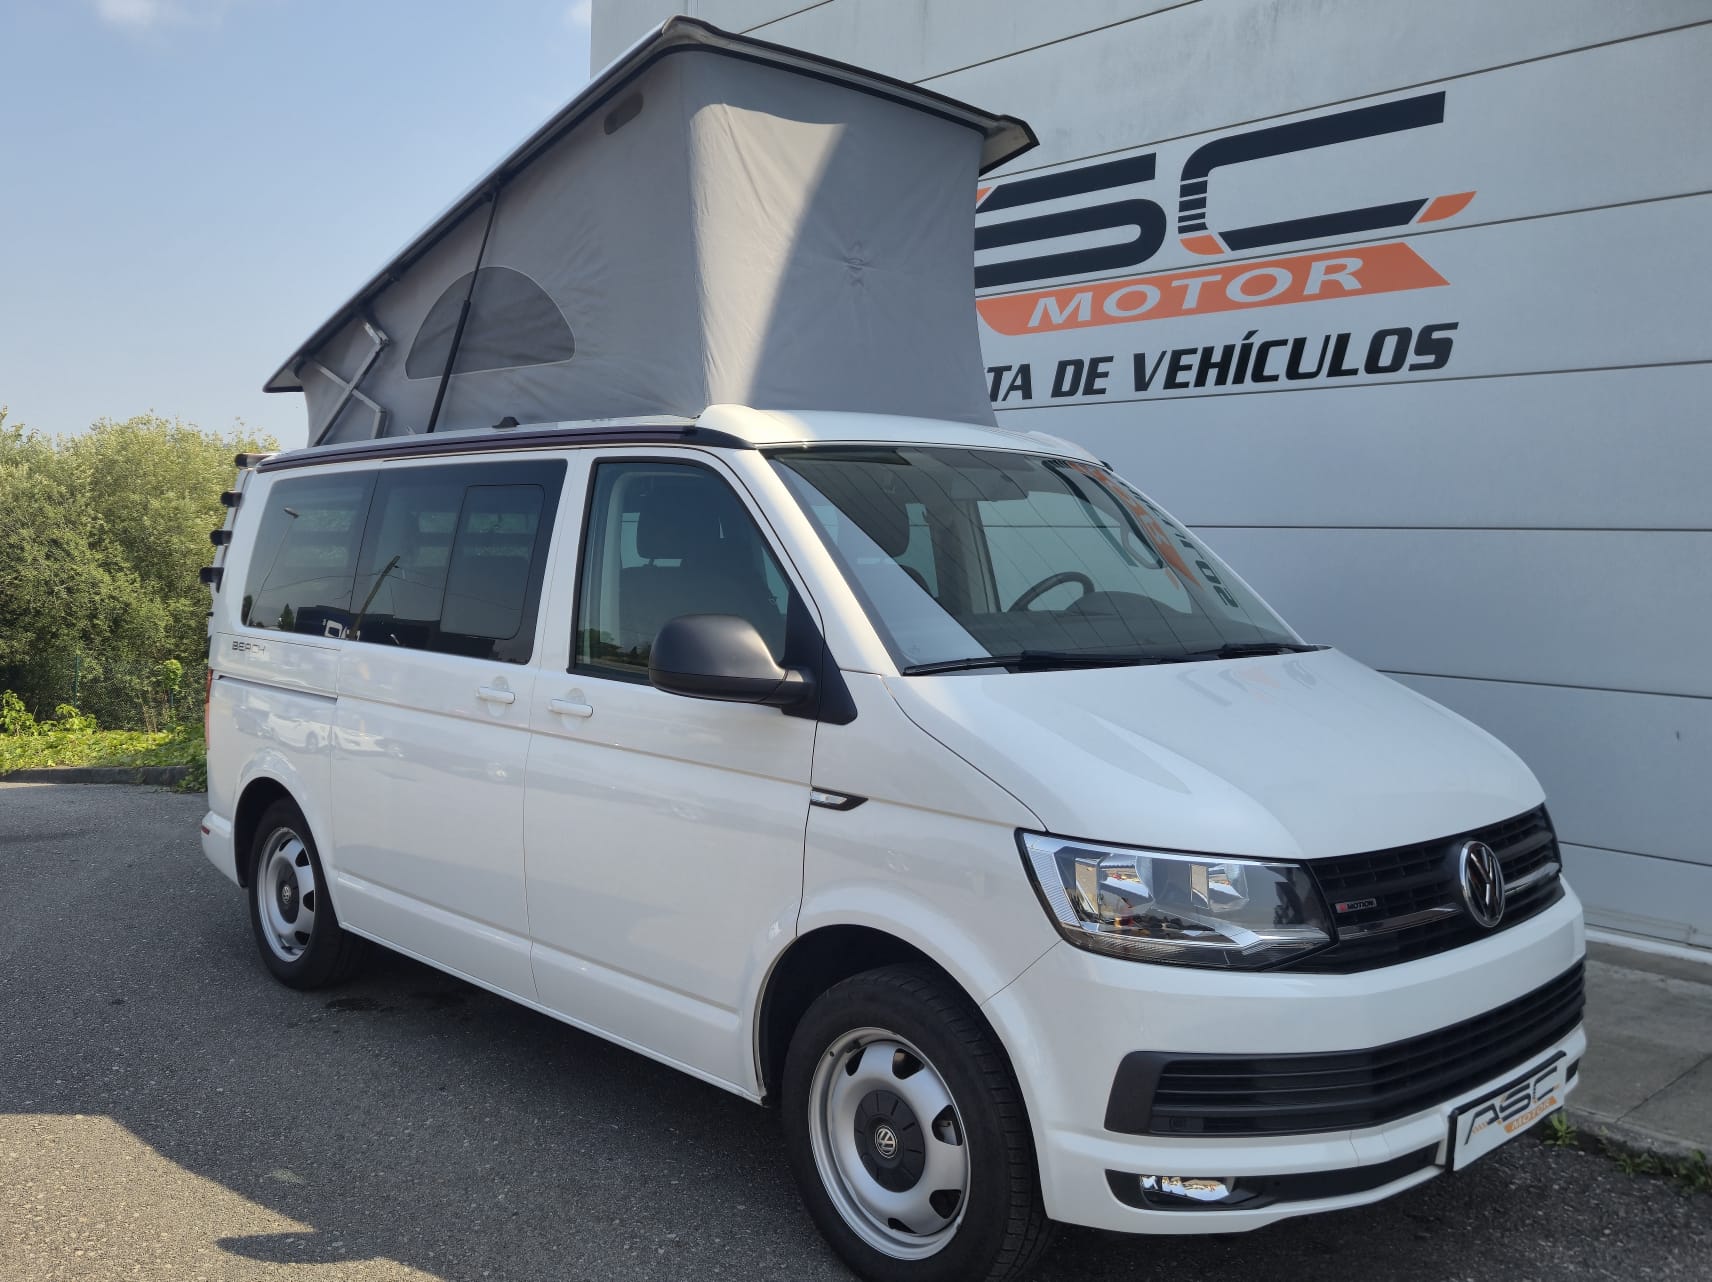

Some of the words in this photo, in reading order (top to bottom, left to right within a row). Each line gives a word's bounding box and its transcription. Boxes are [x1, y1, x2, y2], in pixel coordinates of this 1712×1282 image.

[975, 91, 1477, 289] SC
[1027, 257, 1364, 328] MOTOR
[986, 364, 1032, 402] TA
[1051, 355, 1114, 399] DE
[1132, 321, 1460, 392] VEHÍCULOS
[231, 641, 266, 655] BEACH
[1464, 1065, 1560, 1146] ASC
